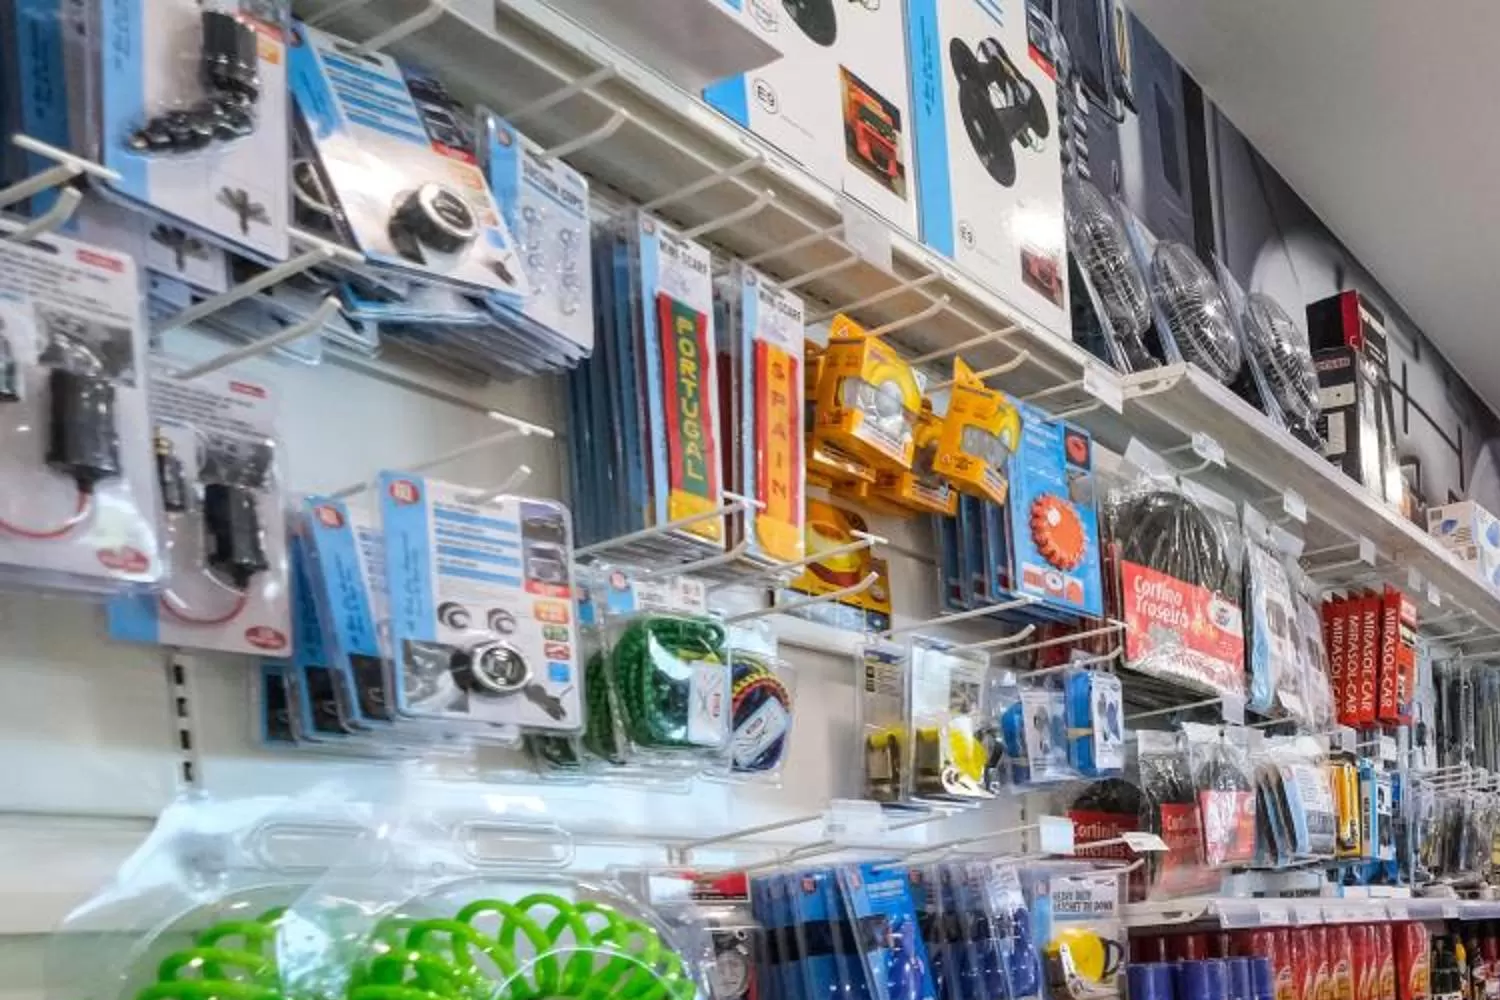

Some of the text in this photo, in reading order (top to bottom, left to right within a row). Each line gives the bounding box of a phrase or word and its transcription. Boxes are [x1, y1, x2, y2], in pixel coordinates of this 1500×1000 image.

[674, 313, 705, 482] PORTUGAL
[768, 360, 787, 500] SPAIN
[1361, 610, 1376, 712] MIRASOL-CAR
[1381, 607, 1397, 708] MIRASOL-CAR
